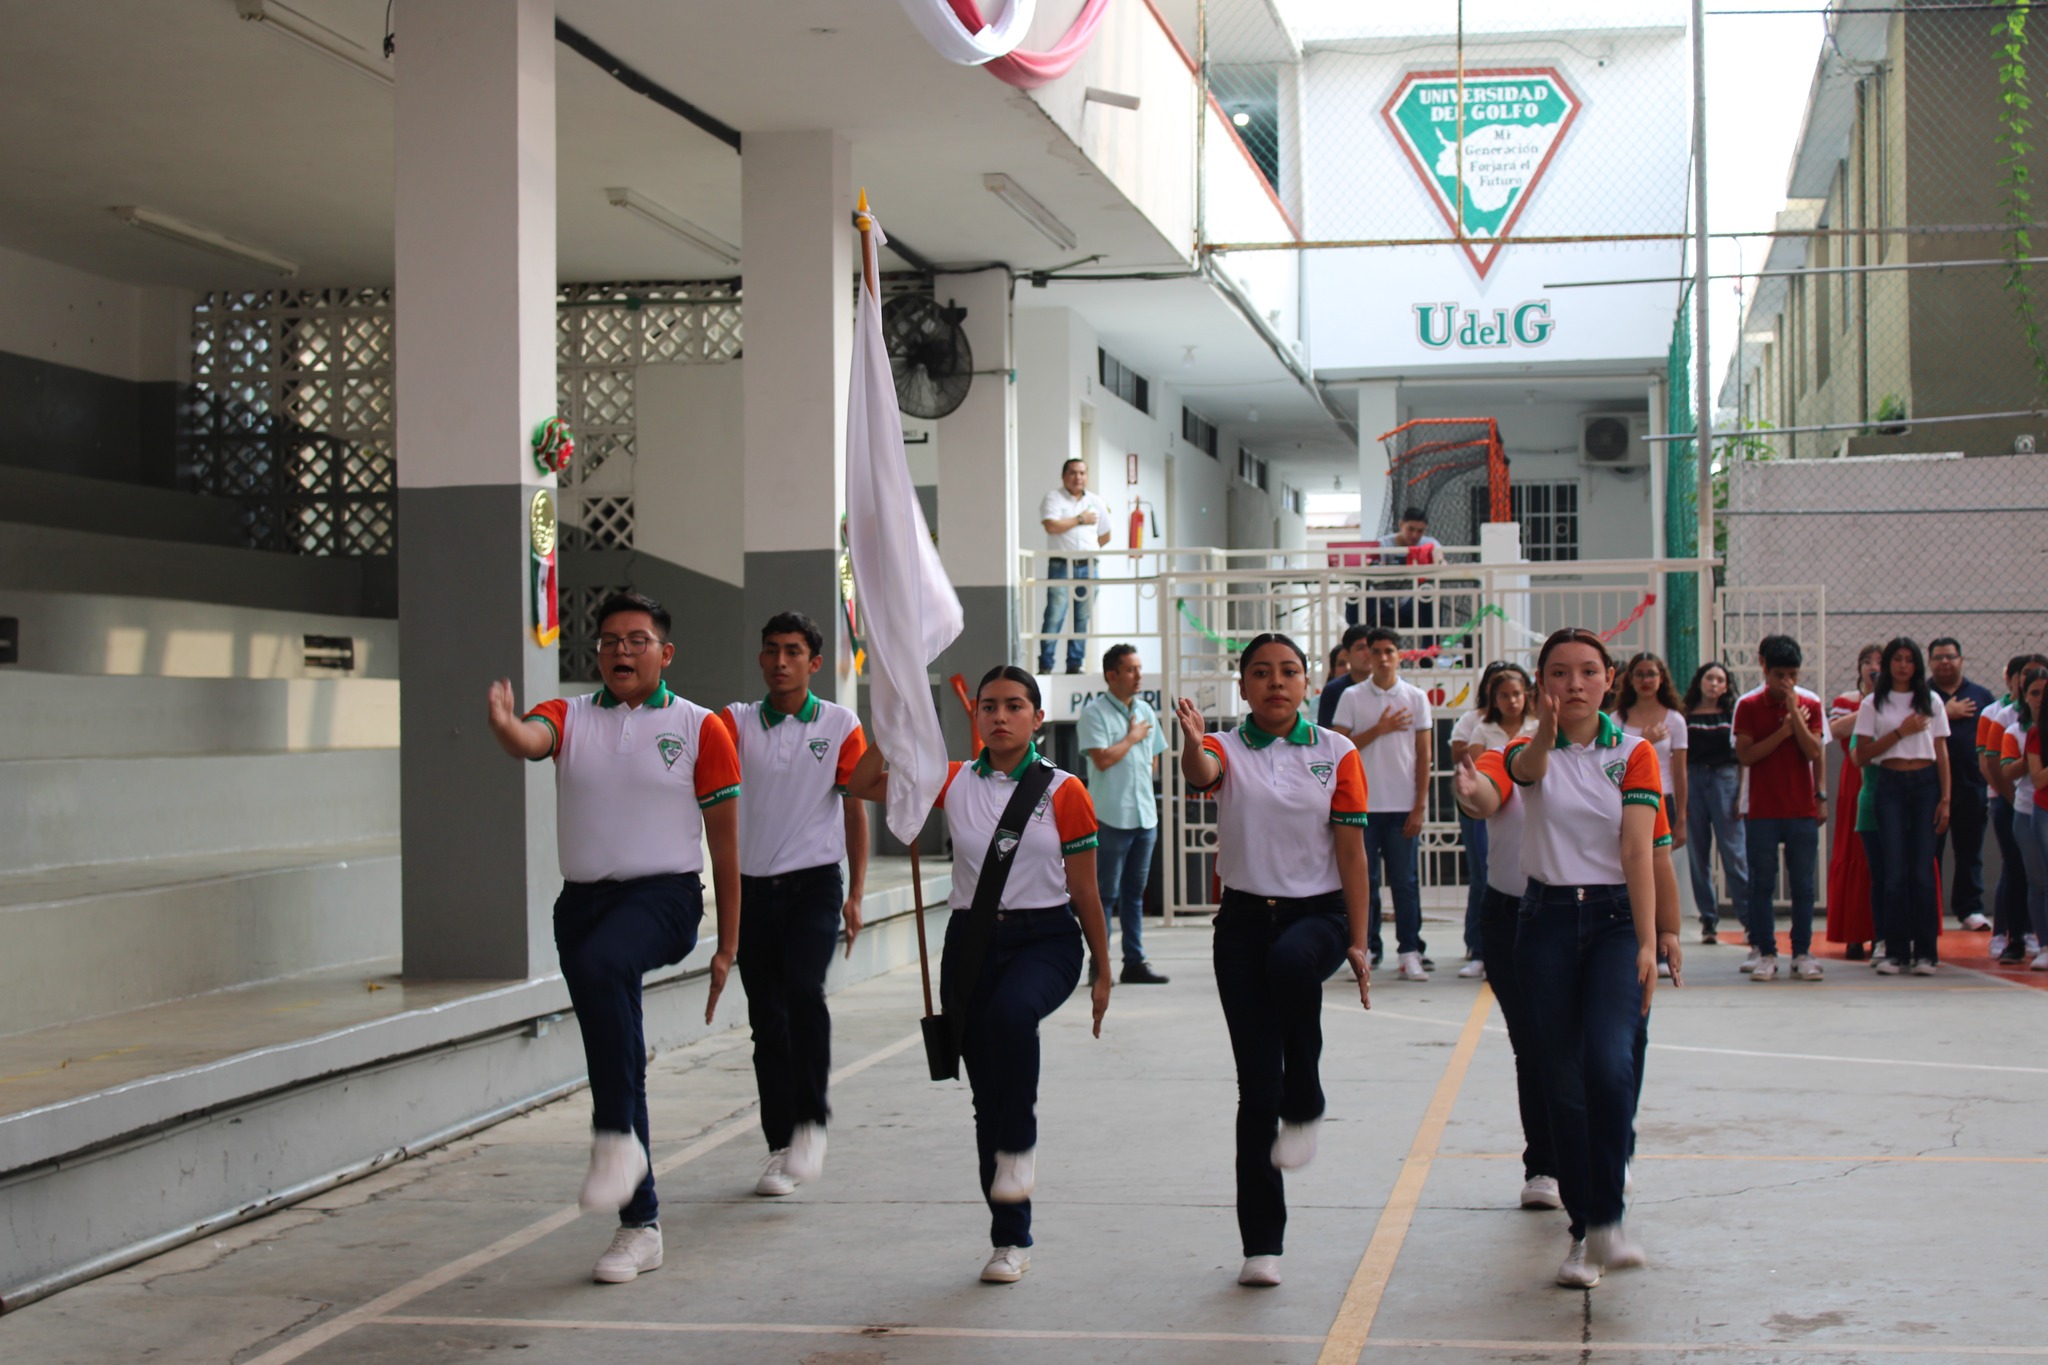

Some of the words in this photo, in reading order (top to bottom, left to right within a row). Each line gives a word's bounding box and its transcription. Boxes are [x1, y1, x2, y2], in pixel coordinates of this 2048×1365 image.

[1419, 85, 1549, 105] UNIVERSIDAD
[1471, 102, 1539, 121] GOLFO
[1494, 129, 1511, 141] Mi
[1520, 160, 1530, 170] el
[1480, 176, 1522, 187] Futuro
[1415, 302, 1553, 347] UdelG
